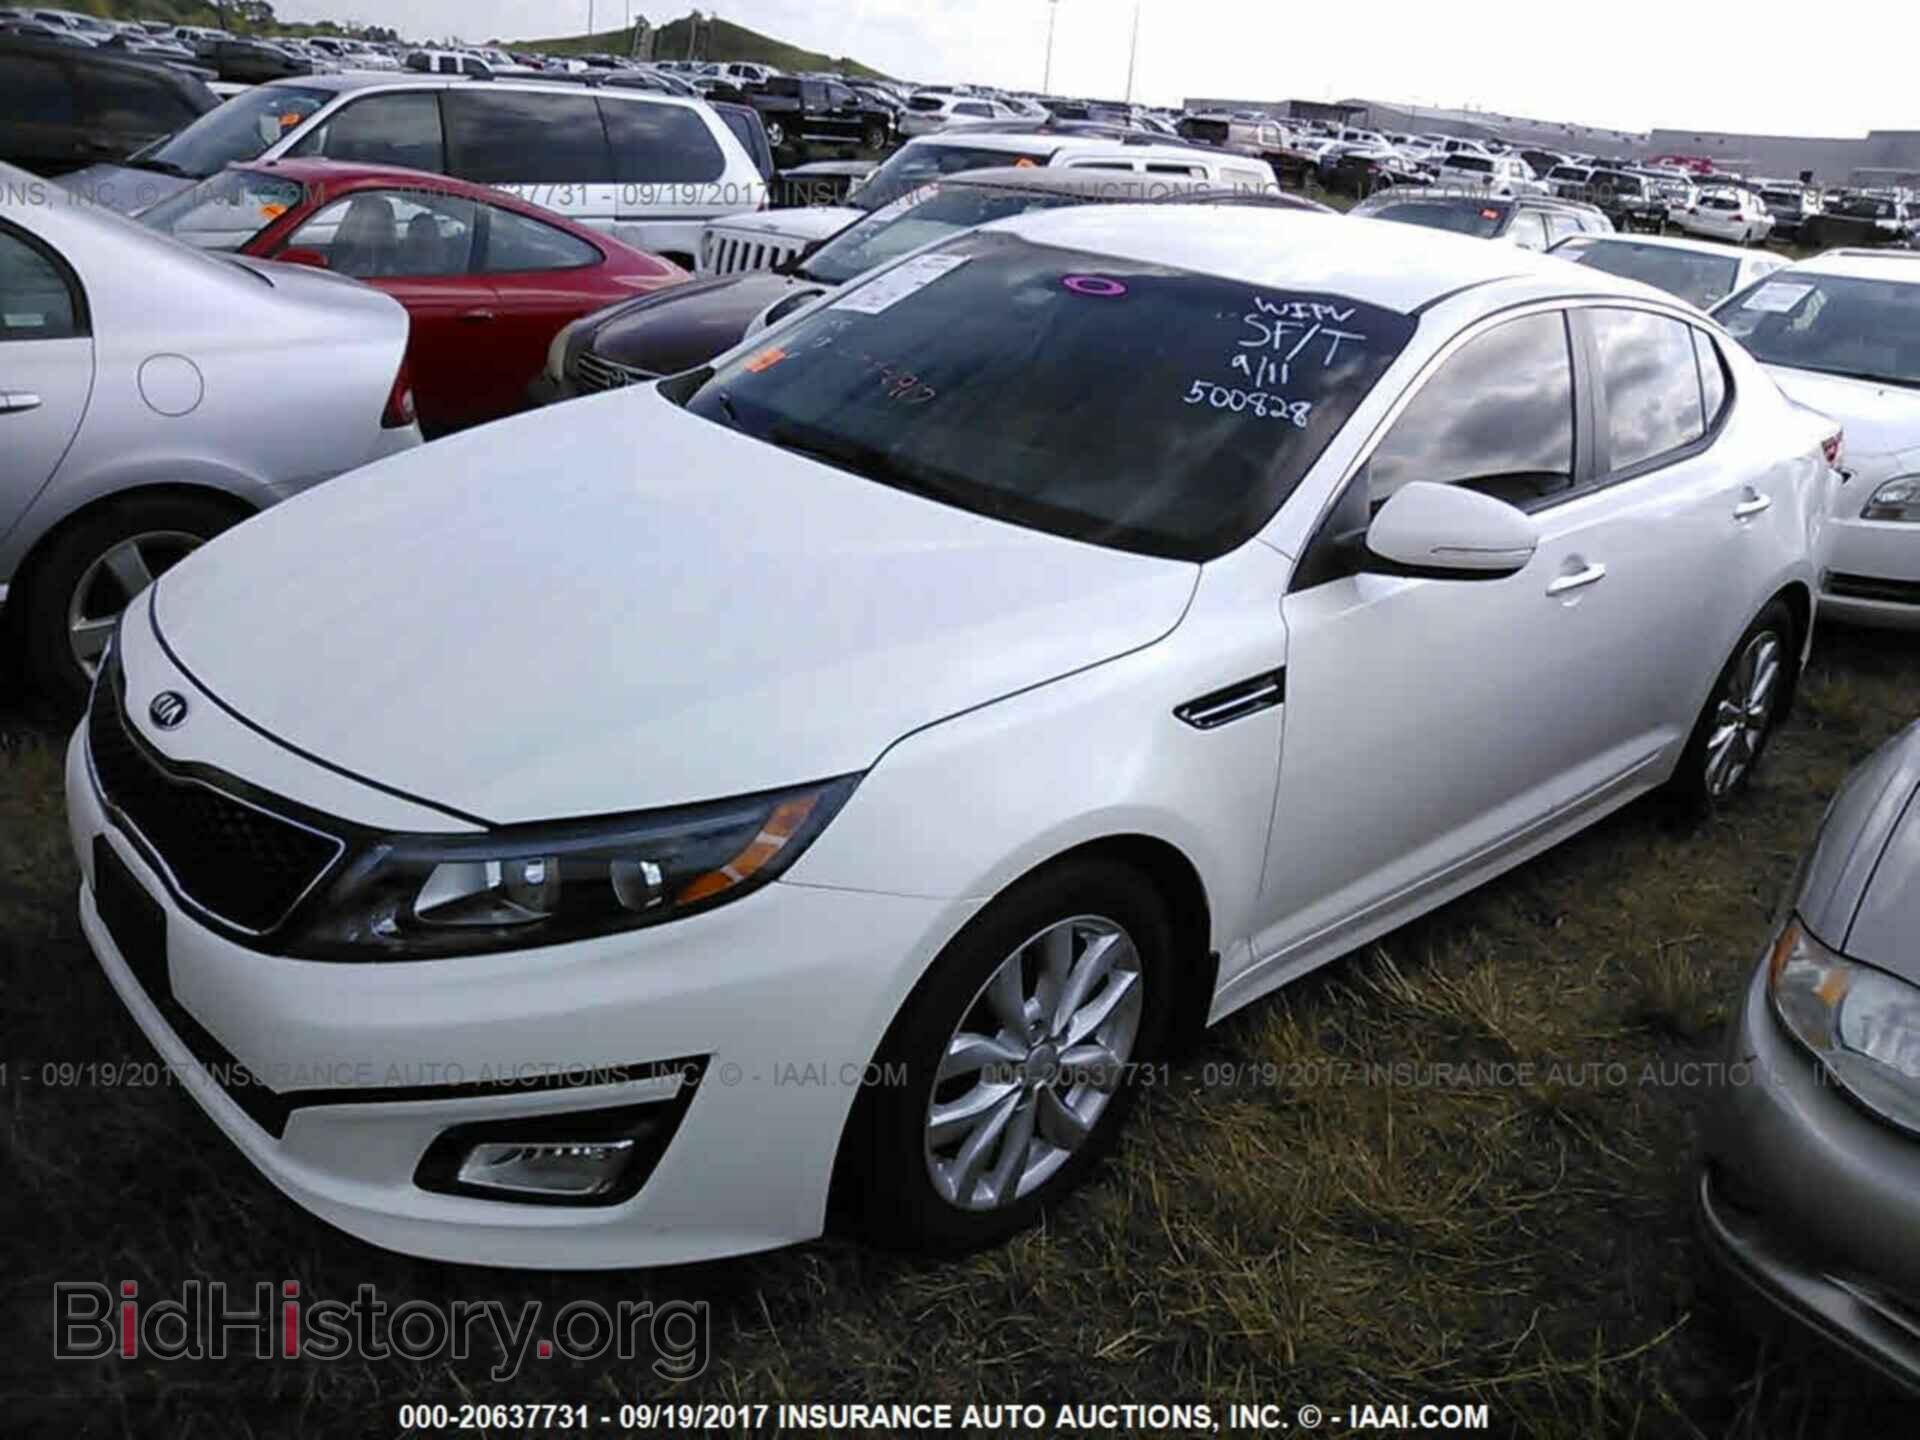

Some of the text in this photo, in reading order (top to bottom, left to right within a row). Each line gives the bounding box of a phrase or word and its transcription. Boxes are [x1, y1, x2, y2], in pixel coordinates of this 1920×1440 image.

[1237, 313, 1368, 367] SF/T
[1231, 353, 1290, 388] 9/11
[1183, 379, 1313, 428] 500828
